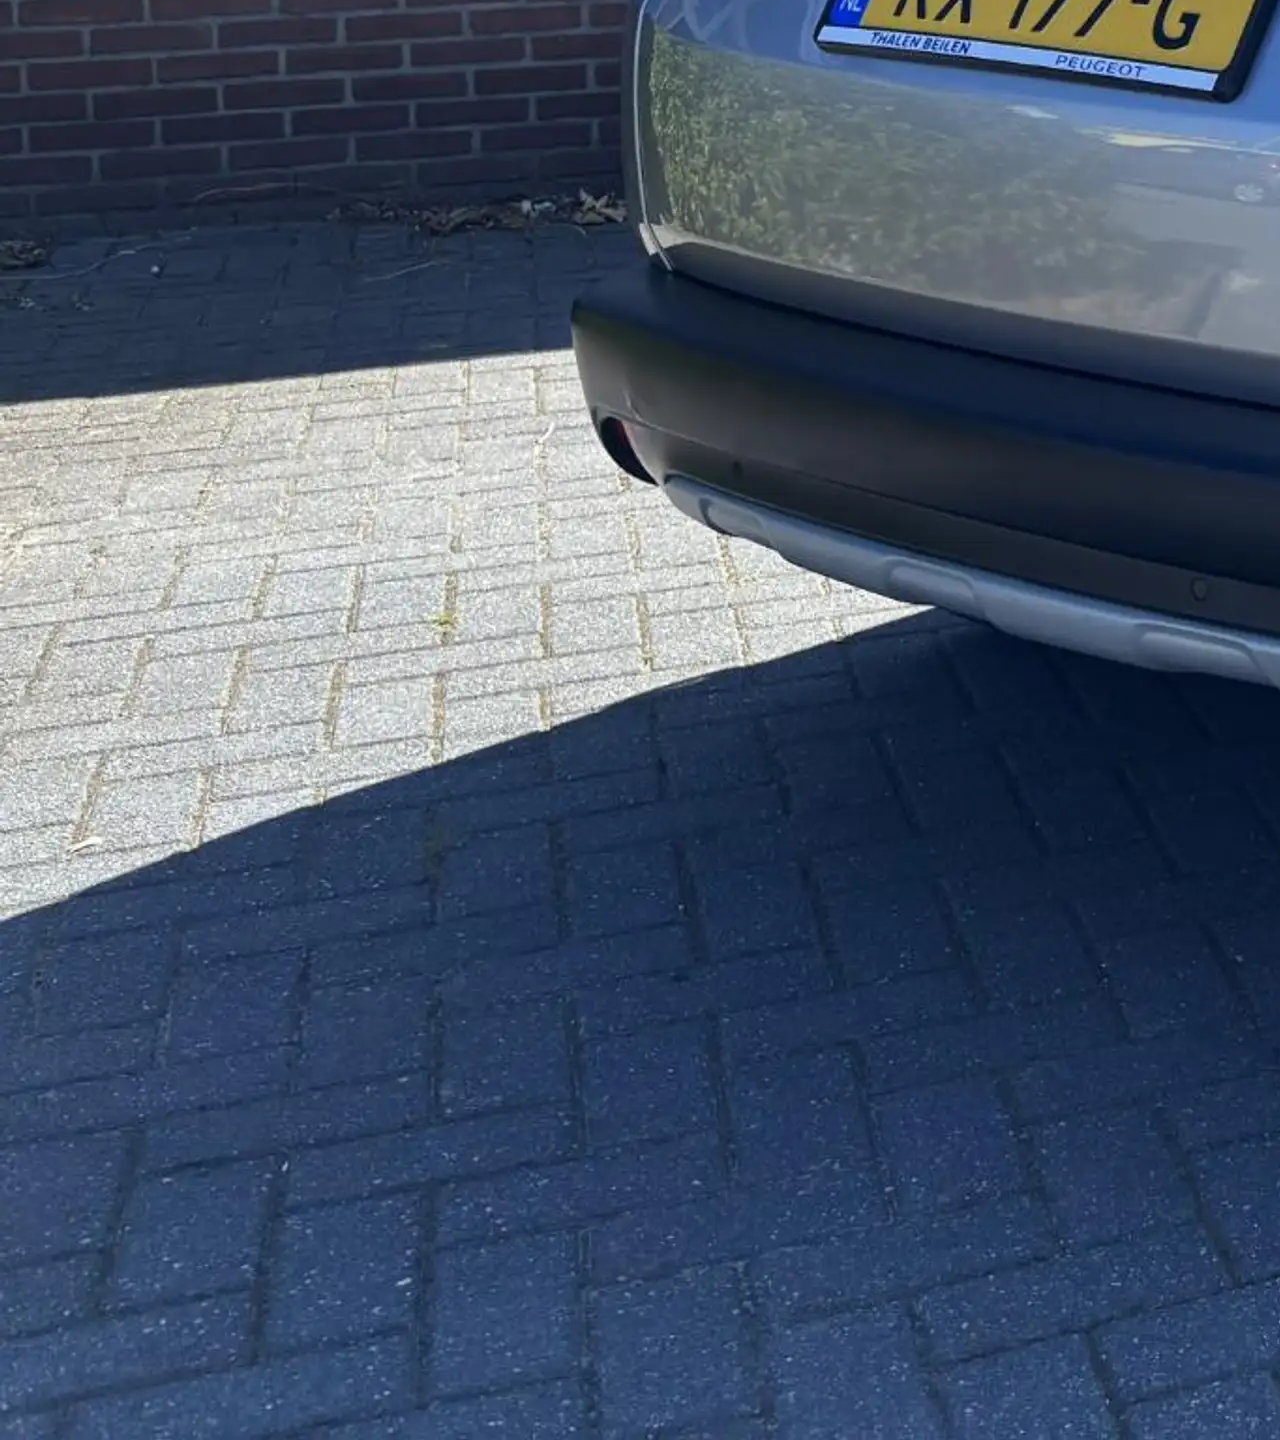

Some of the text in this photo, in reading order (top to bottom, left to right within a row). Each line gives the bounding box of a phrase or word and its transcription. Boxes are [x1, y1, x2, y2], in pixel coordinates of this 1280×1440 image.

[869, 31, 972, 55] THALEN BEILEN
[1053, 53, 1147, 78] PEUGEOT
